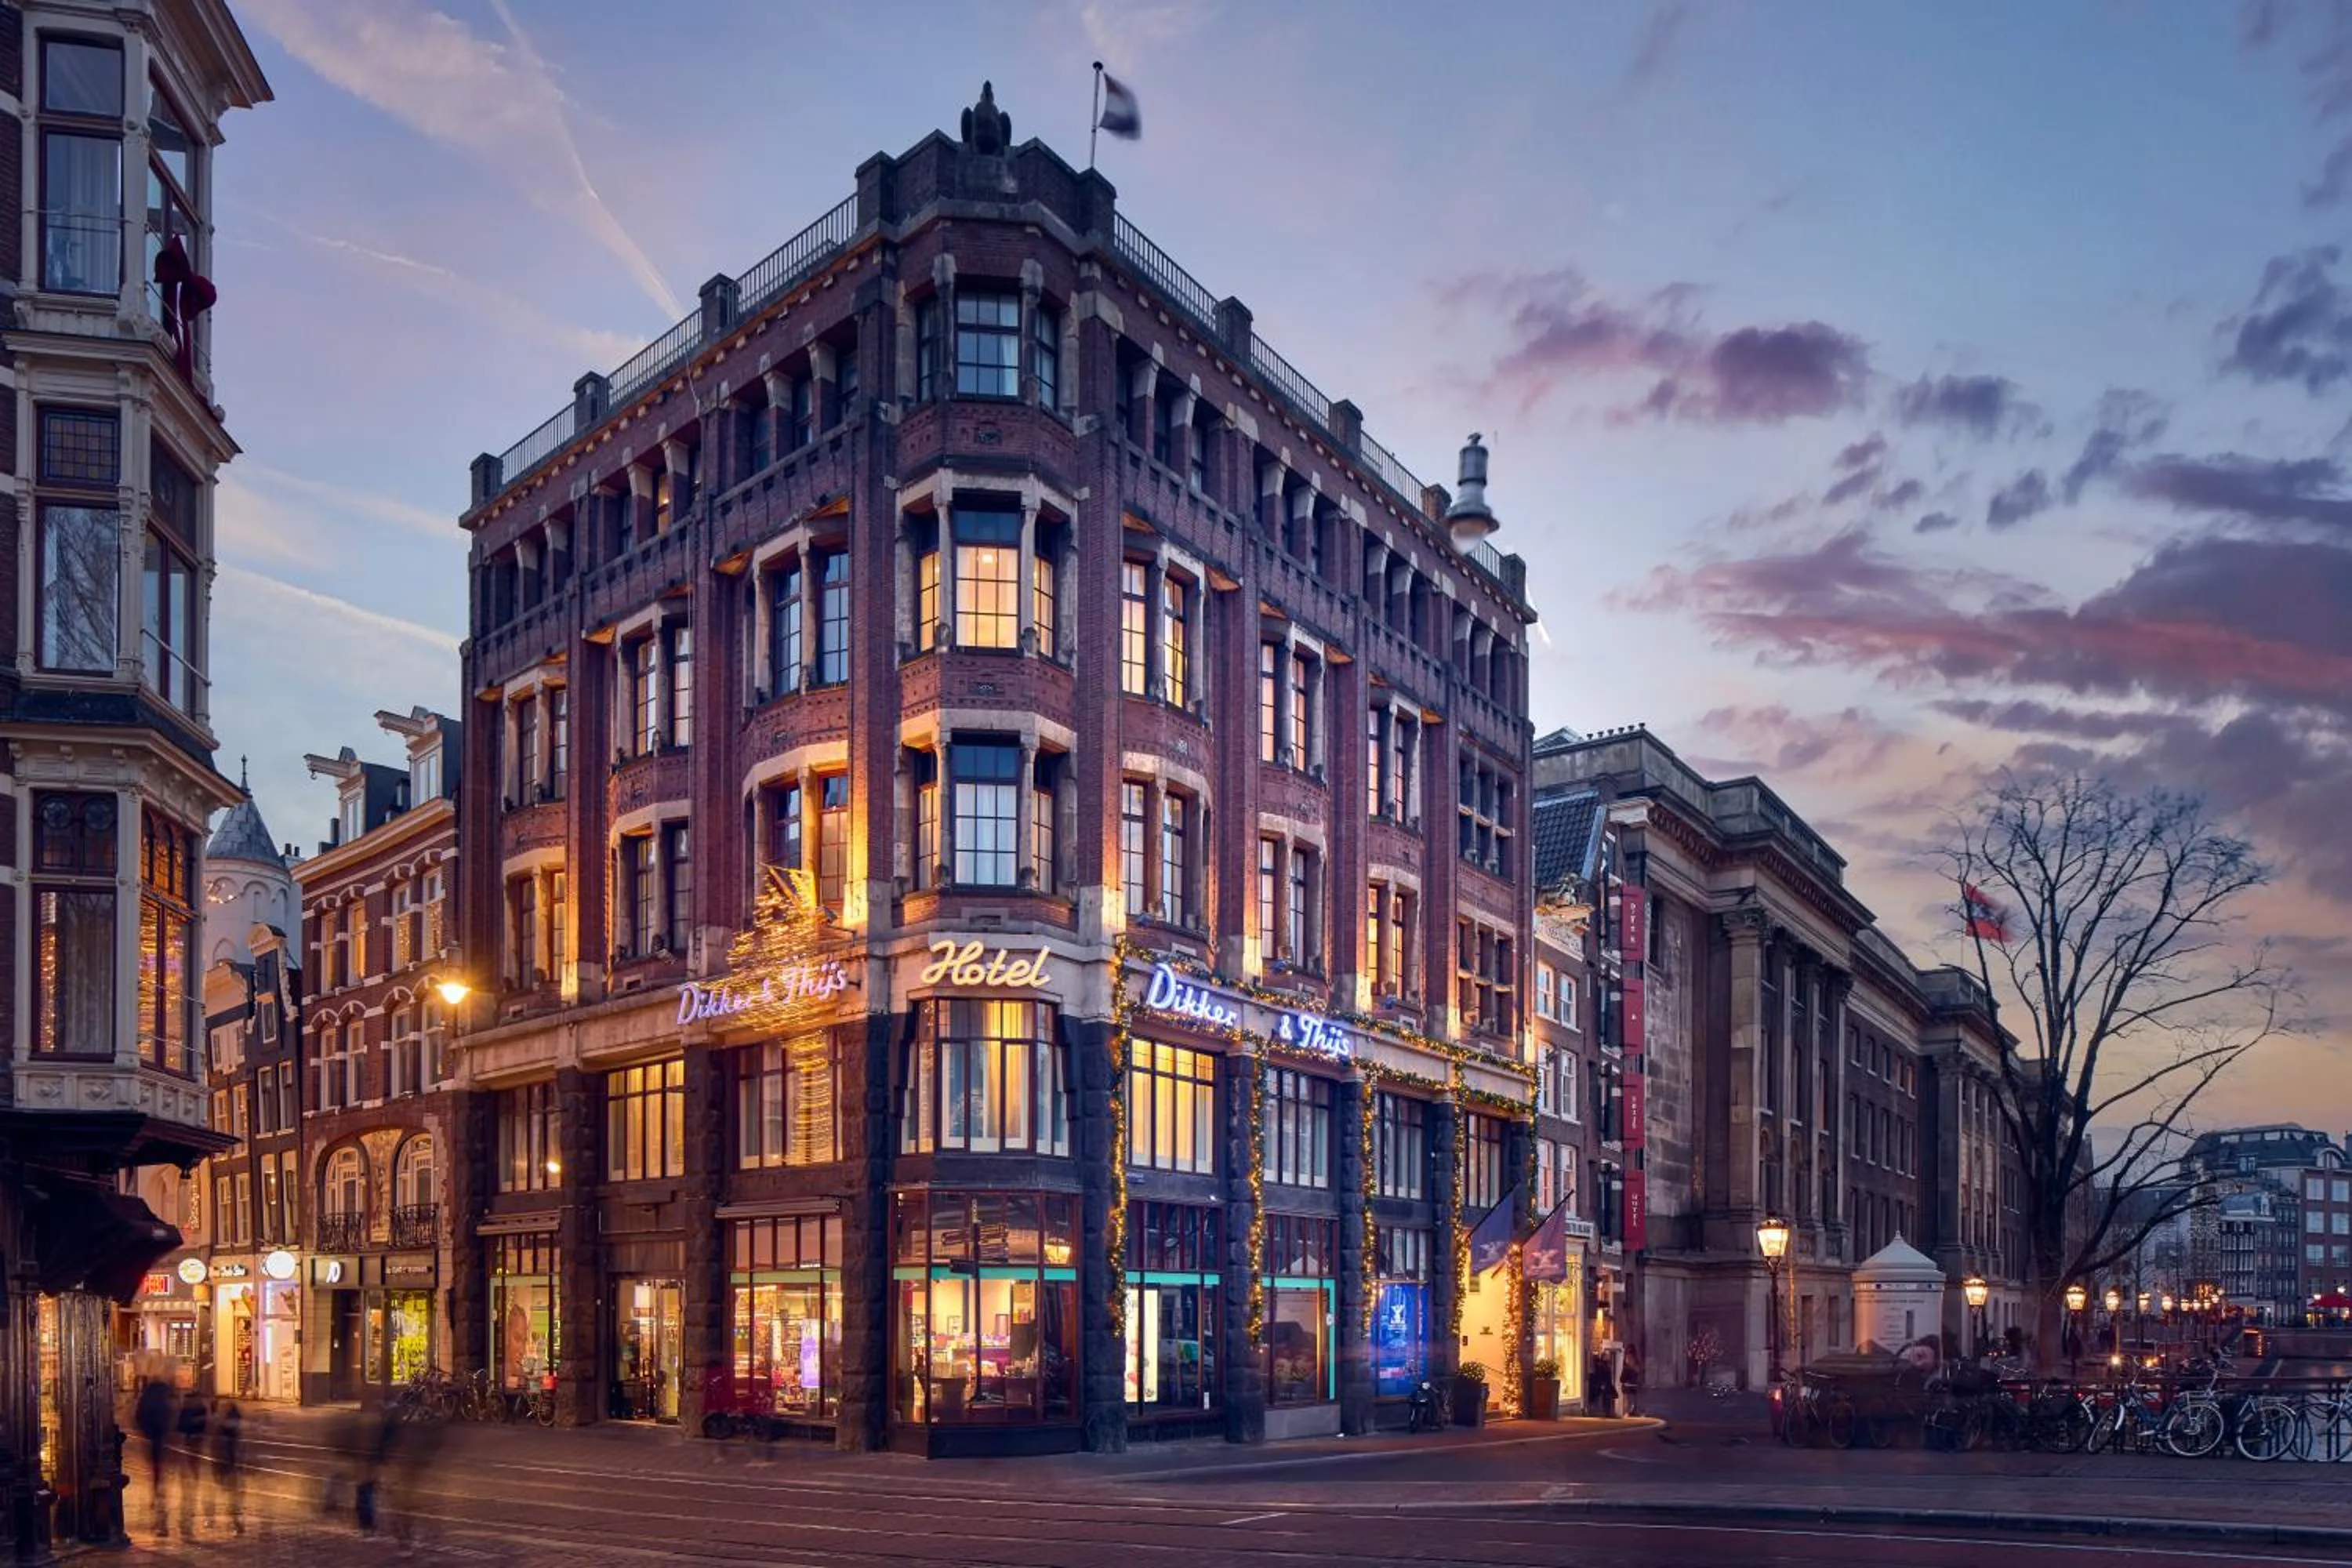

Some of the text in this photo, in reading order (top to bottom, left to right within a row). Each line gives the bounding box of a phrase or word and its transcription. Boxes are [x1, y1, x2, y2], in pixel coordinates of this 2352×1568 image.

[782, 961, 847, 1004] Thijs
[920, 939, 1051, 987] Hotel
[1146, 963, 1350, 1057] Dikker & Thijs
